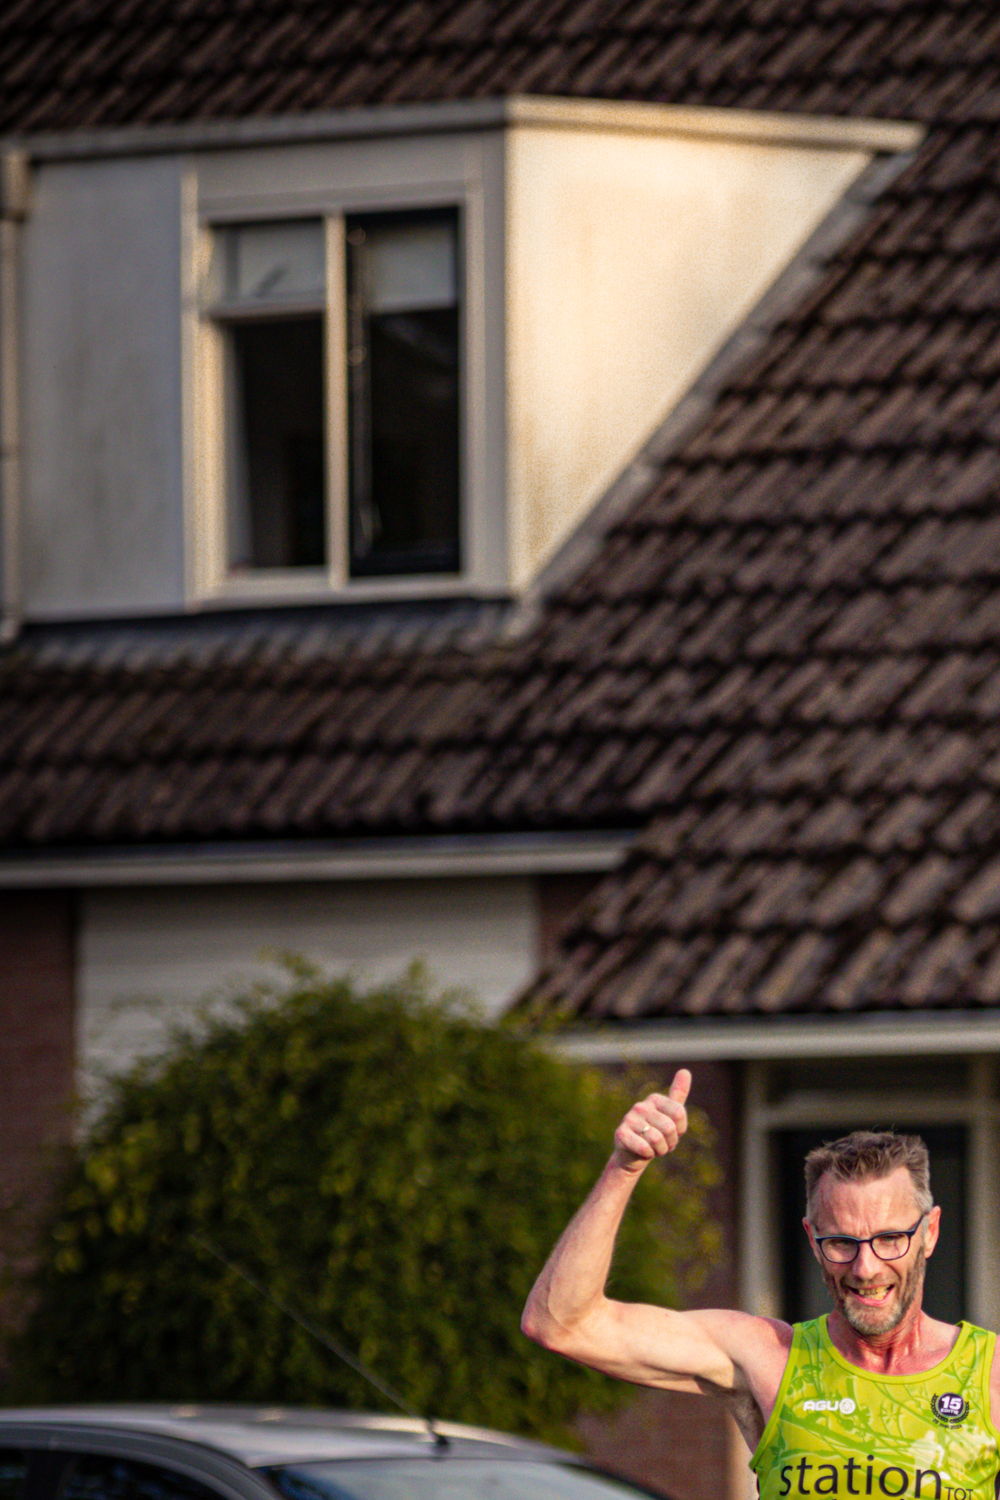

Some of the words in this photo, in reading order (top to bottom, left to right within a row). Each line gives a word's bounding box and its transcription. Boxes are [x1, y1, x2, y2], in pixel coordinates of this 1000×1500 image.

[803, 1399, 839, 1411] AGU
[941, 1396, 962, 1410] 15
[779, 1454, 942, 1500] station
